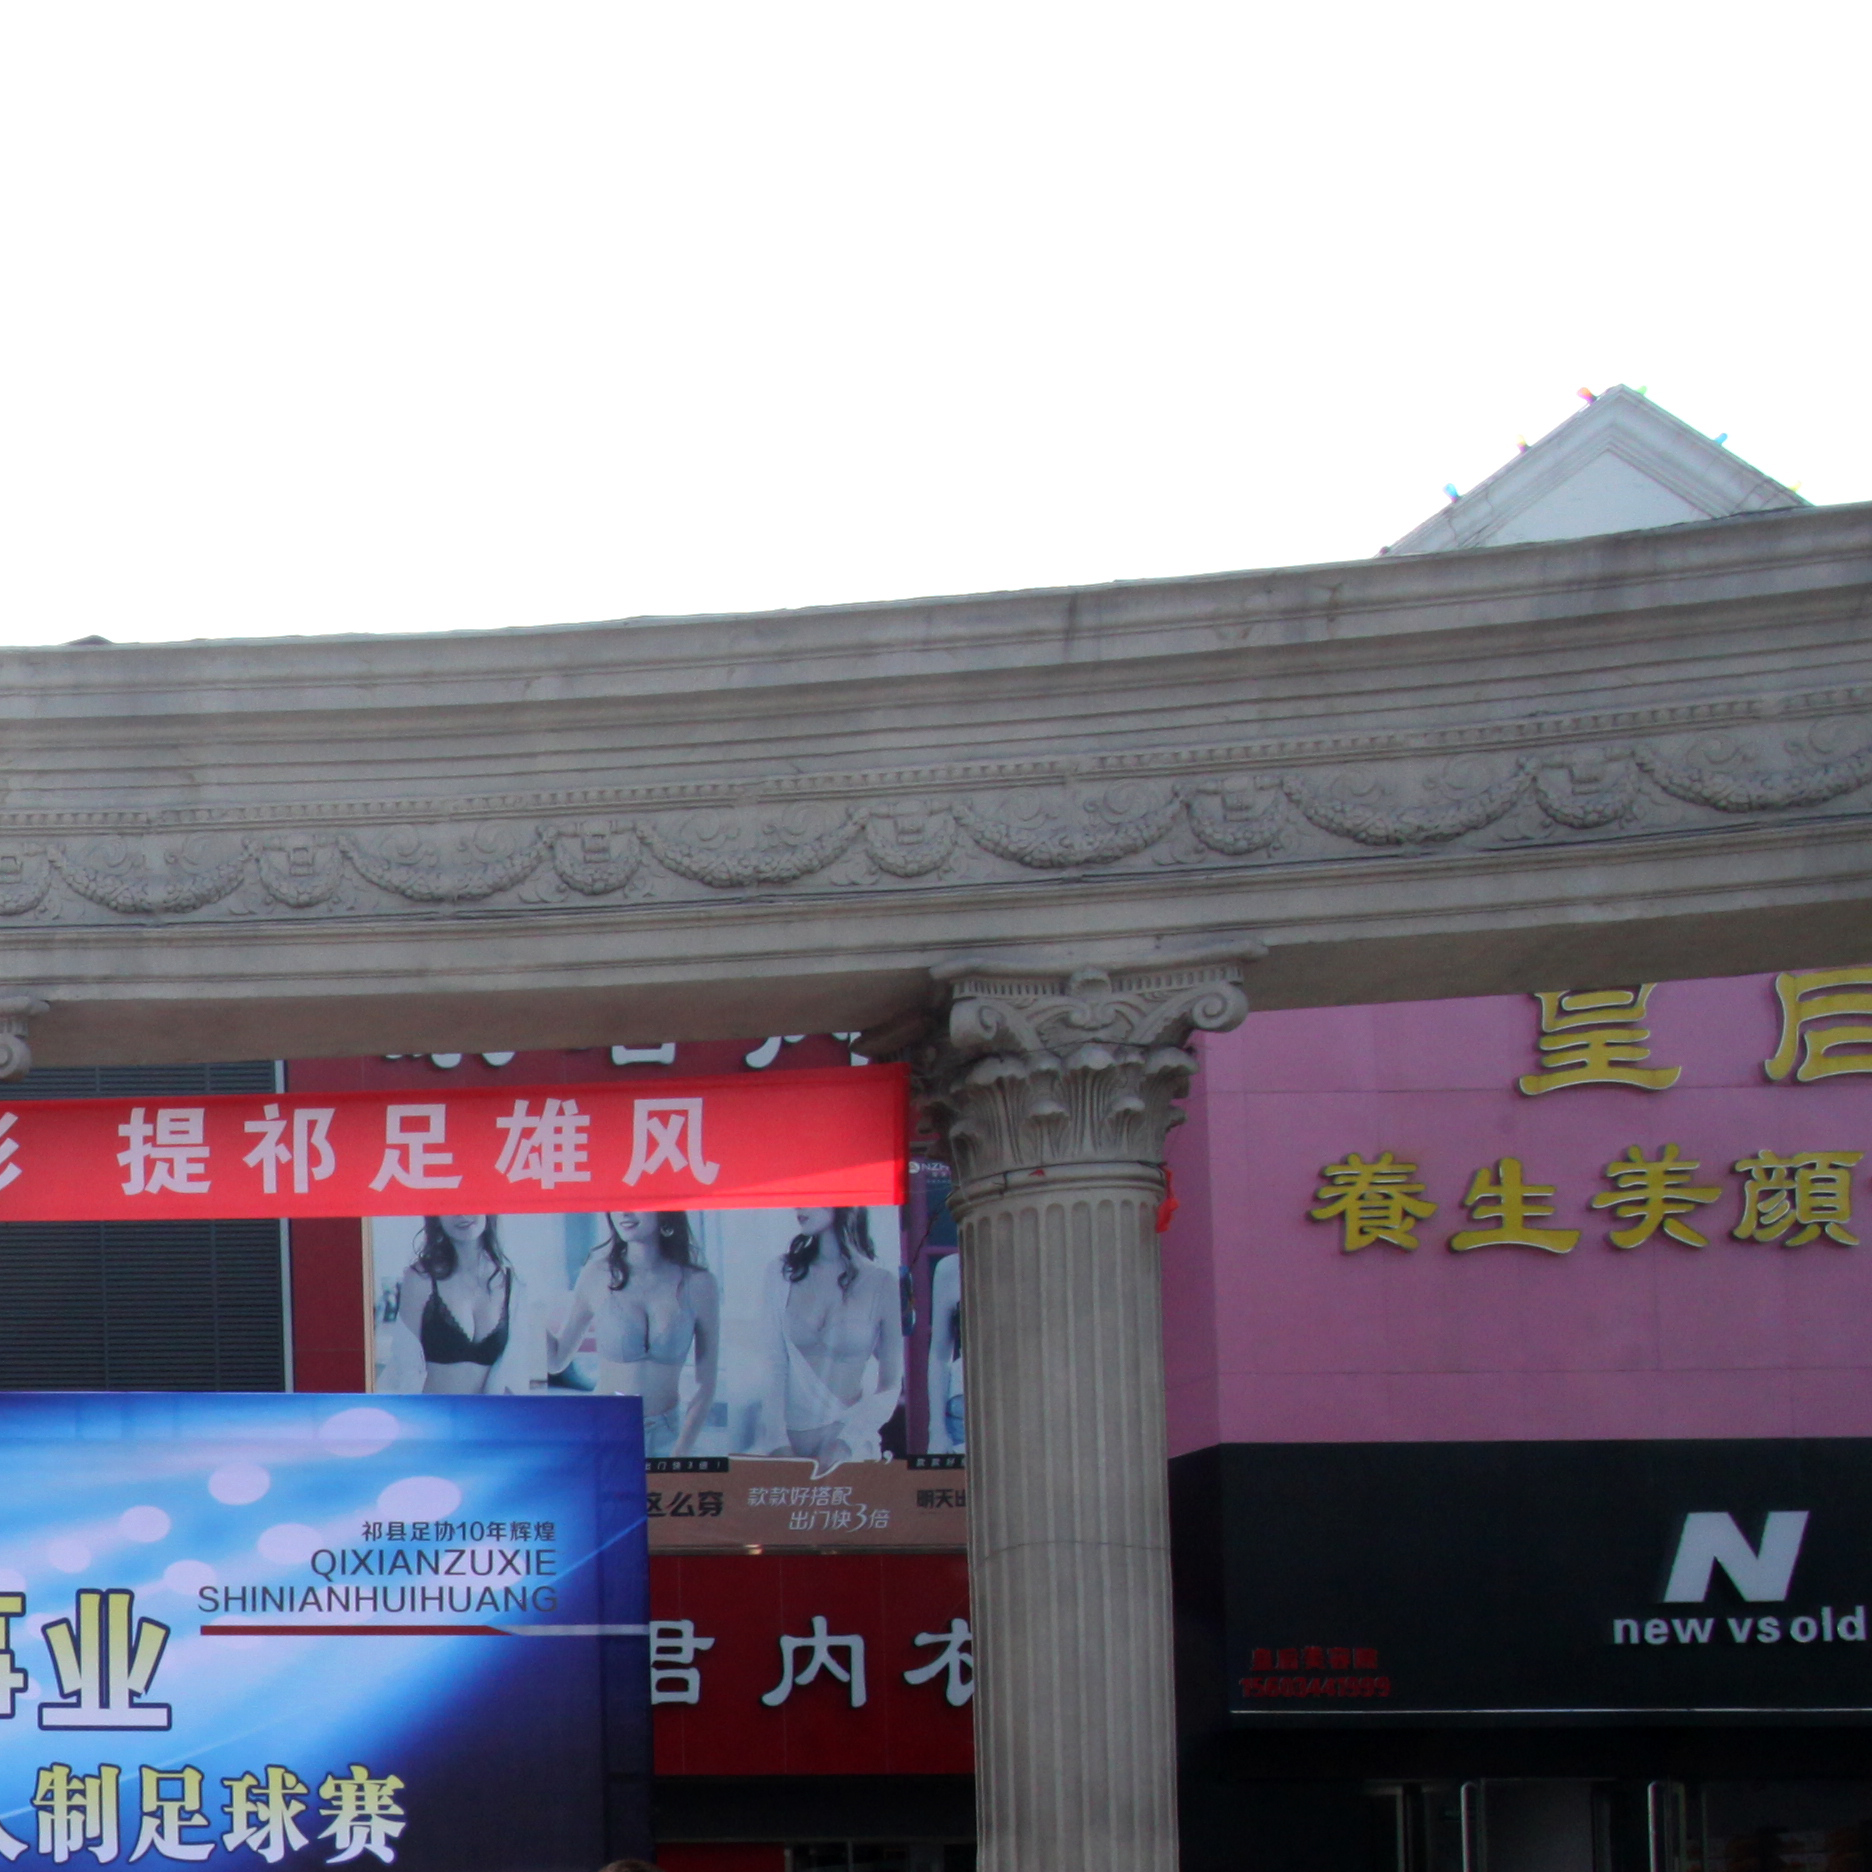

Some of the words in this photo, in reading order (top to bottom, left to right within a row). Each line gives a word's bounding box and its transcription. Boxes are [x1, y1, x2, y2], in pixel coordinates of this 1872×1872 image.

[1517, 967, 1872, 1096] 皇后
[116, 1096, 723, 1196] 提祁足雄风
[747, 1485, 854, 1507] 款款好搭配
[360, 1520, 557, 1543] 祁县足协10年辉煌
[788, 1503, 892, 1533] 出门快3倍
[310, 1547, 558, 1580] QIXIANZUXIE
[197, 1585, 560, 1614] SHINIANHUIHUANG
